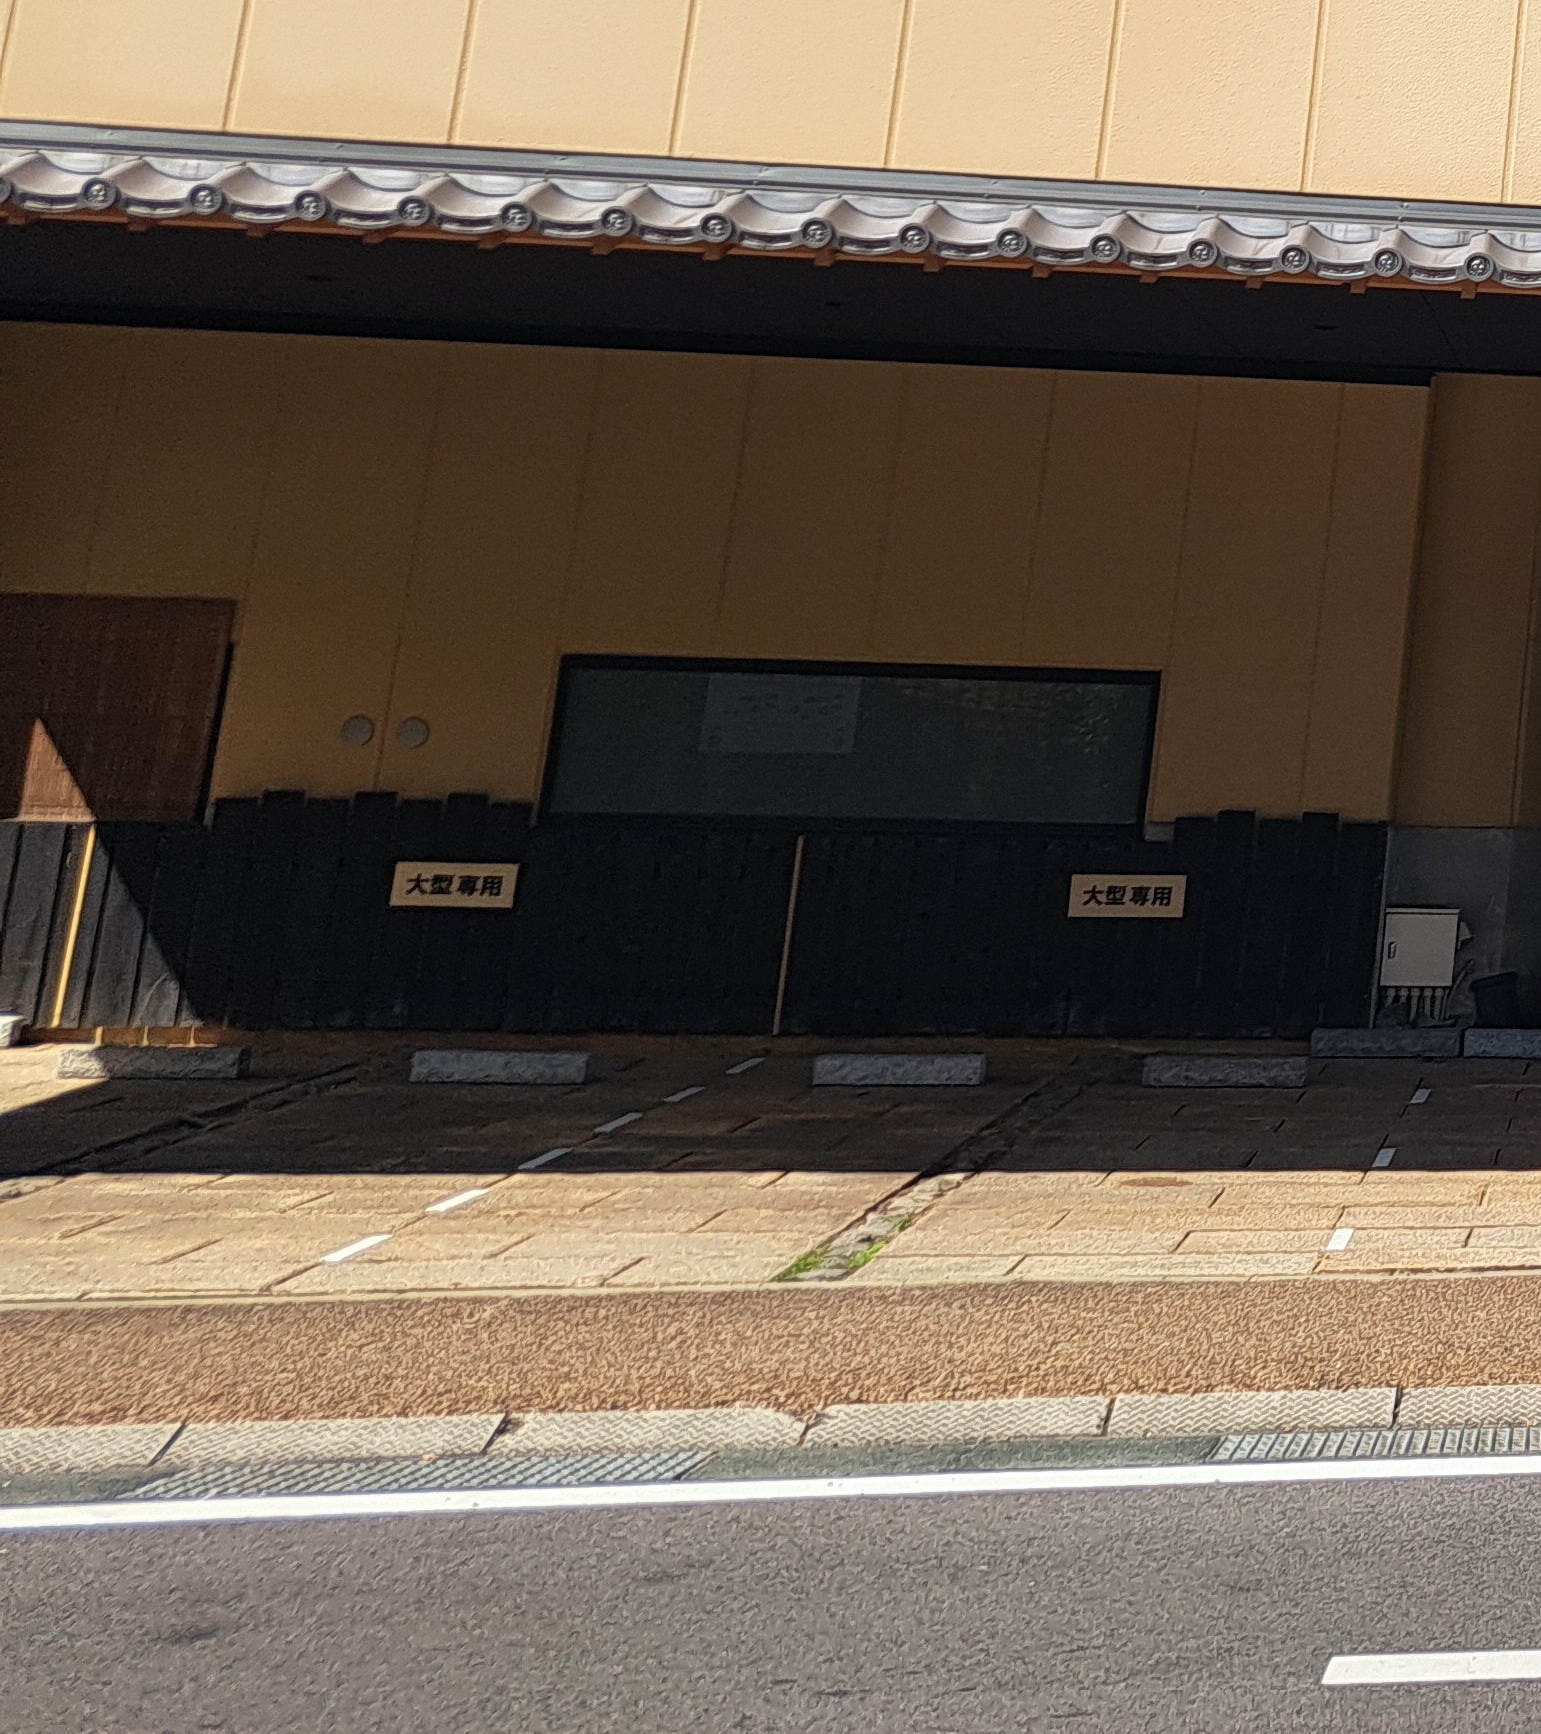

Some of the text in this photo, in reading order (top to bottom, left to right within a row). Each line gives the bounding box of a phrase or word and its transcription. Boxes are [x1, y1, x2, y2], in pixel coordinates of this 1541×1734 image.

[405, 872, 504, 897] 大型専用
[1082, 884, 1174, 907] 大型専用
